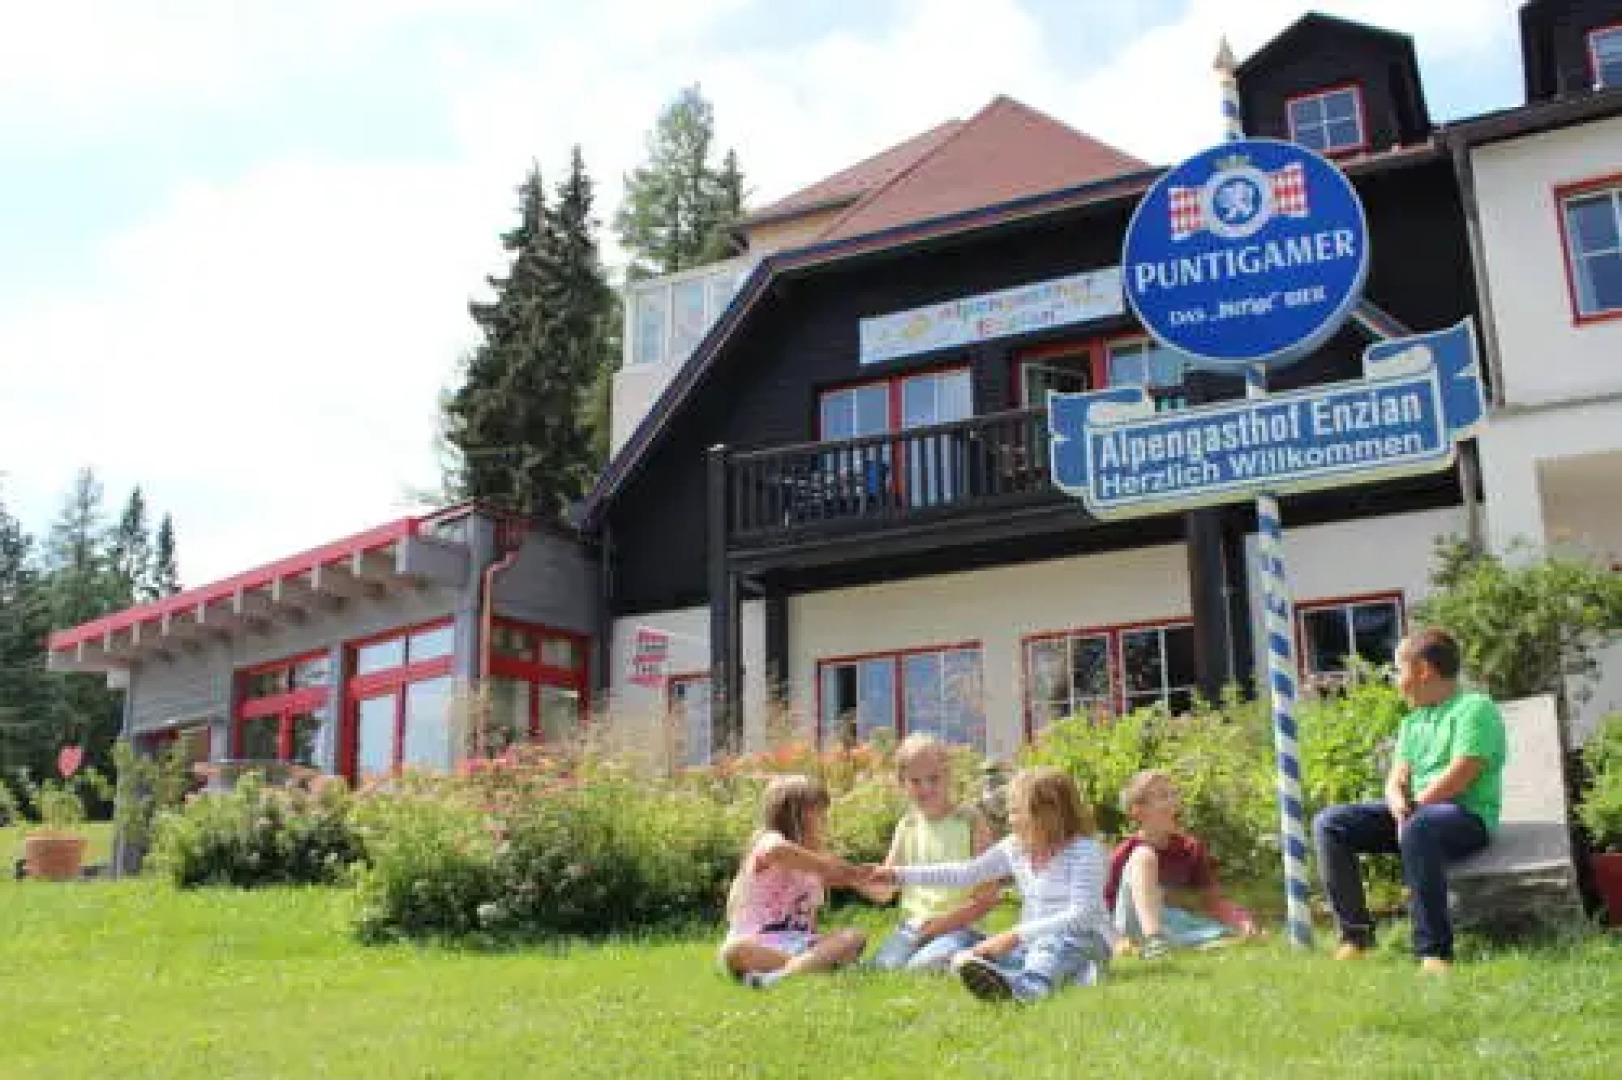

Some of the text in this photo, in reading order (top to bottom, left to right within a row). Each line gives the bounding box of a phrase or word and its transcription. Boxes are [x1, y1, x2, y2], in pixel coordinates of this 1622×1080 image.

[1134, 229, 1354, 293] PUNTIGAMER
[1102, 391, 1422, 472] Alpengasthof Enzian
[1102, 433, 1422, 497] Herzlich Willkommen
